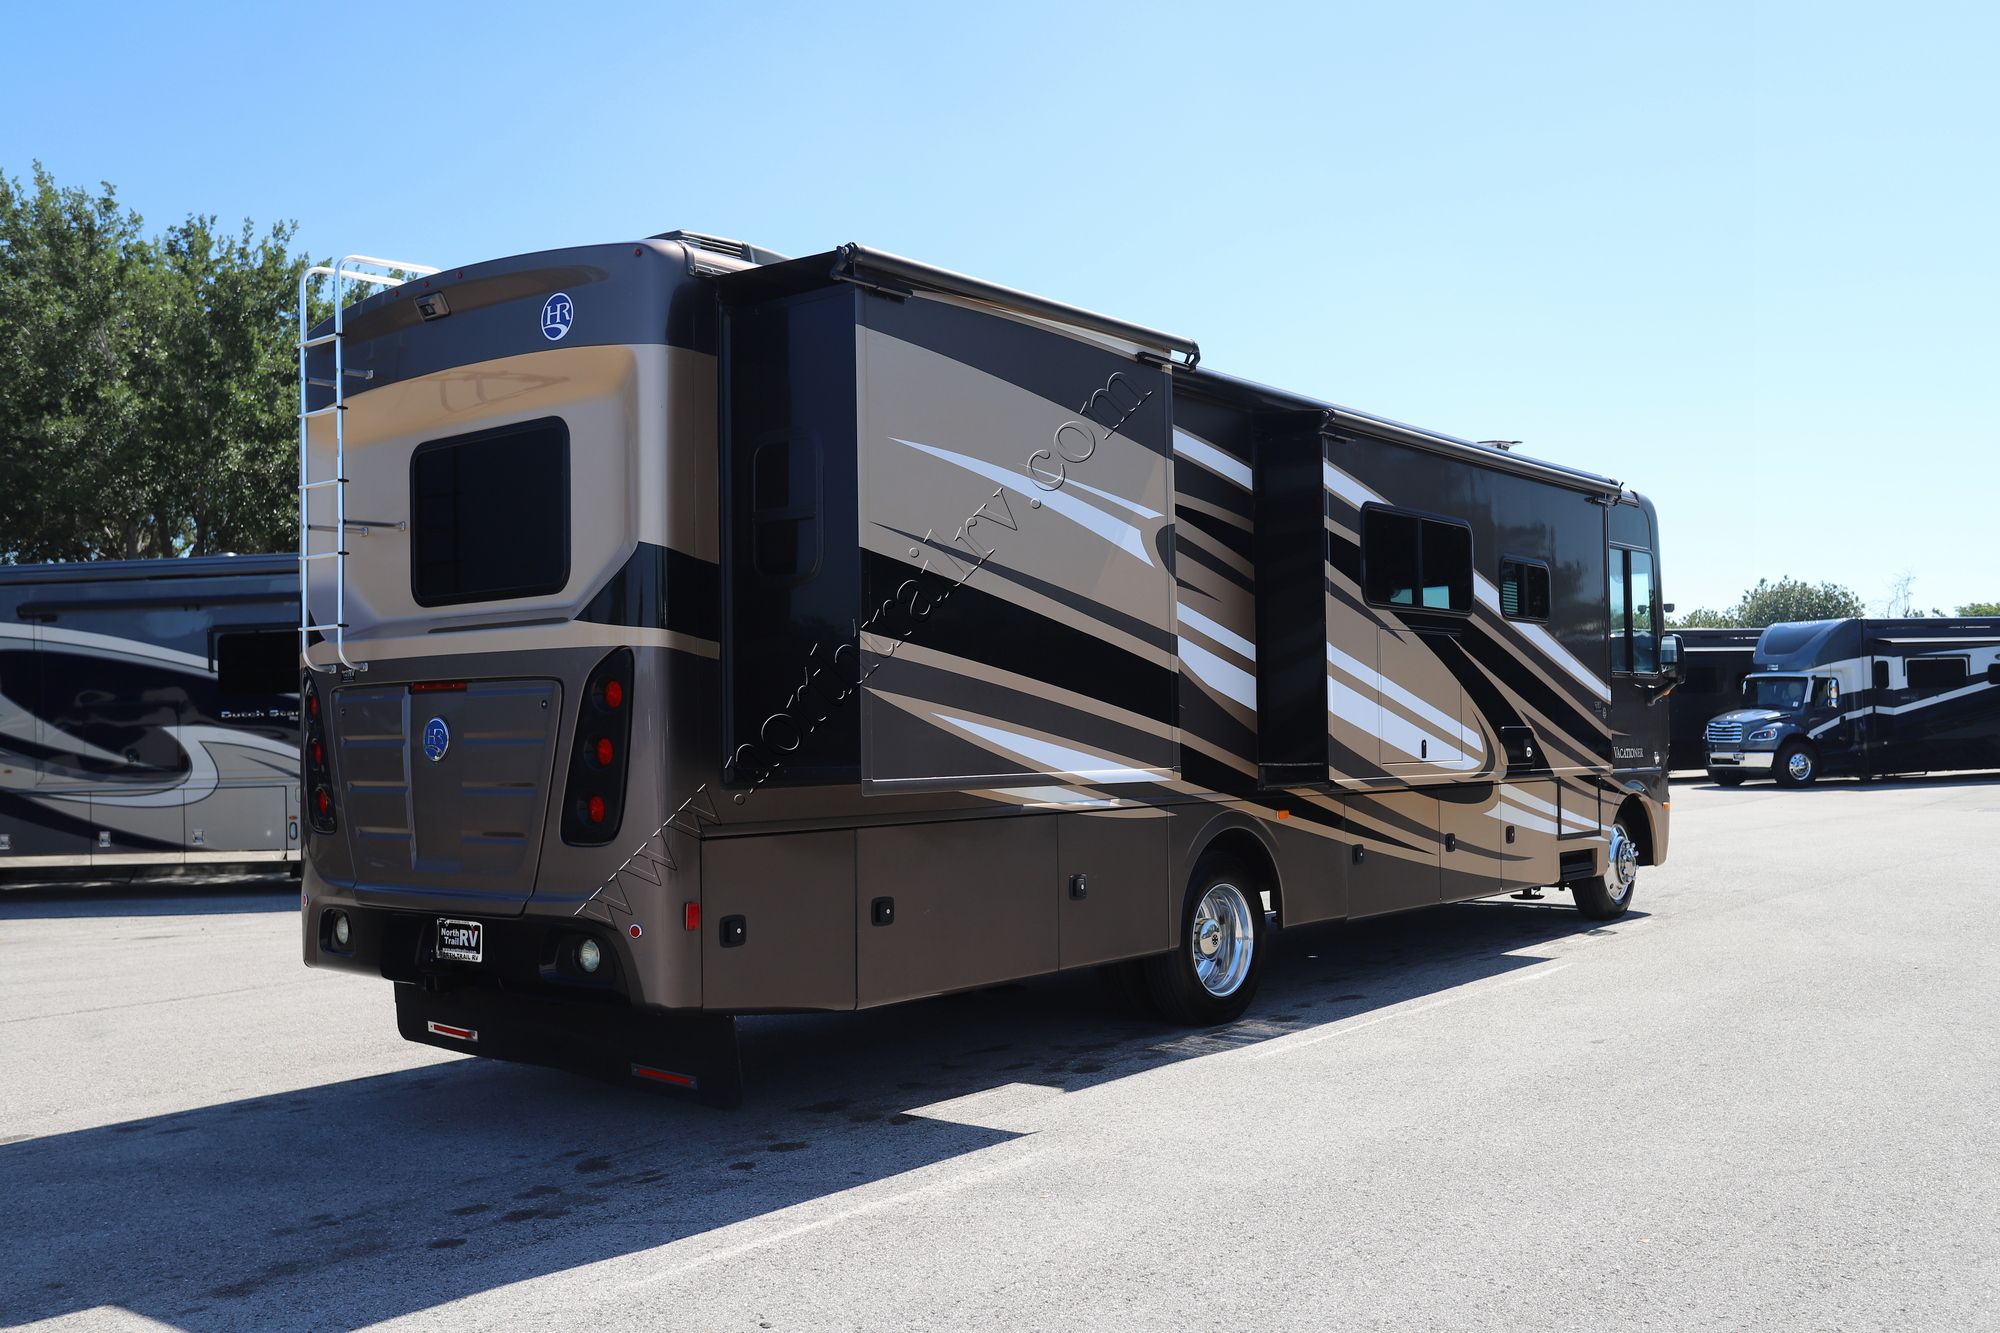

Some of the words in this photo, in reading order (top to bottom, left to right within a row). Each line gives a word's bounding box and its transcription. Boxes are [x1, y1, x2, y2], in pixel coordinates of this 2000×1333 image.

[546, 302, 571, 325] HR
[441, 927, 460, 937] North
[459, 929, 479, 947] RV
[444, 936, 460, 946] Trail
